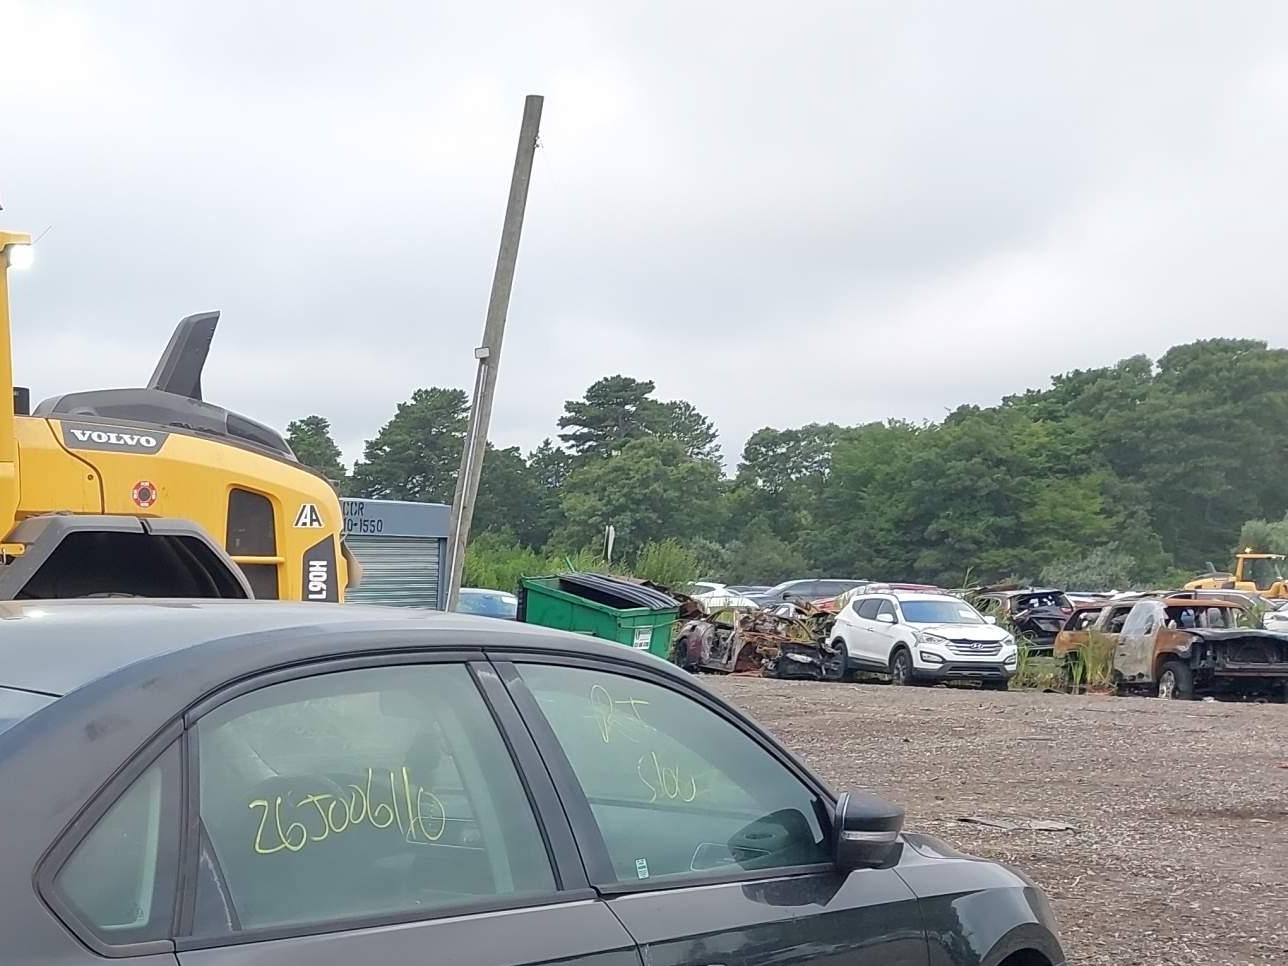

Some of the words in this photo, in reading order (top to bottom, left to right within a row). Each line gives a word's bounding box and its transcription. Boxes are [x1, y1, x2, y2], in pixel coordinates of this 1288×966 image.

[69, 429, 157, 447] VOLVO
[343, 501, 365, 516] CCR
[308, 560, 328, 600] L90H
[249, 766, 446, 853] 26J006110
